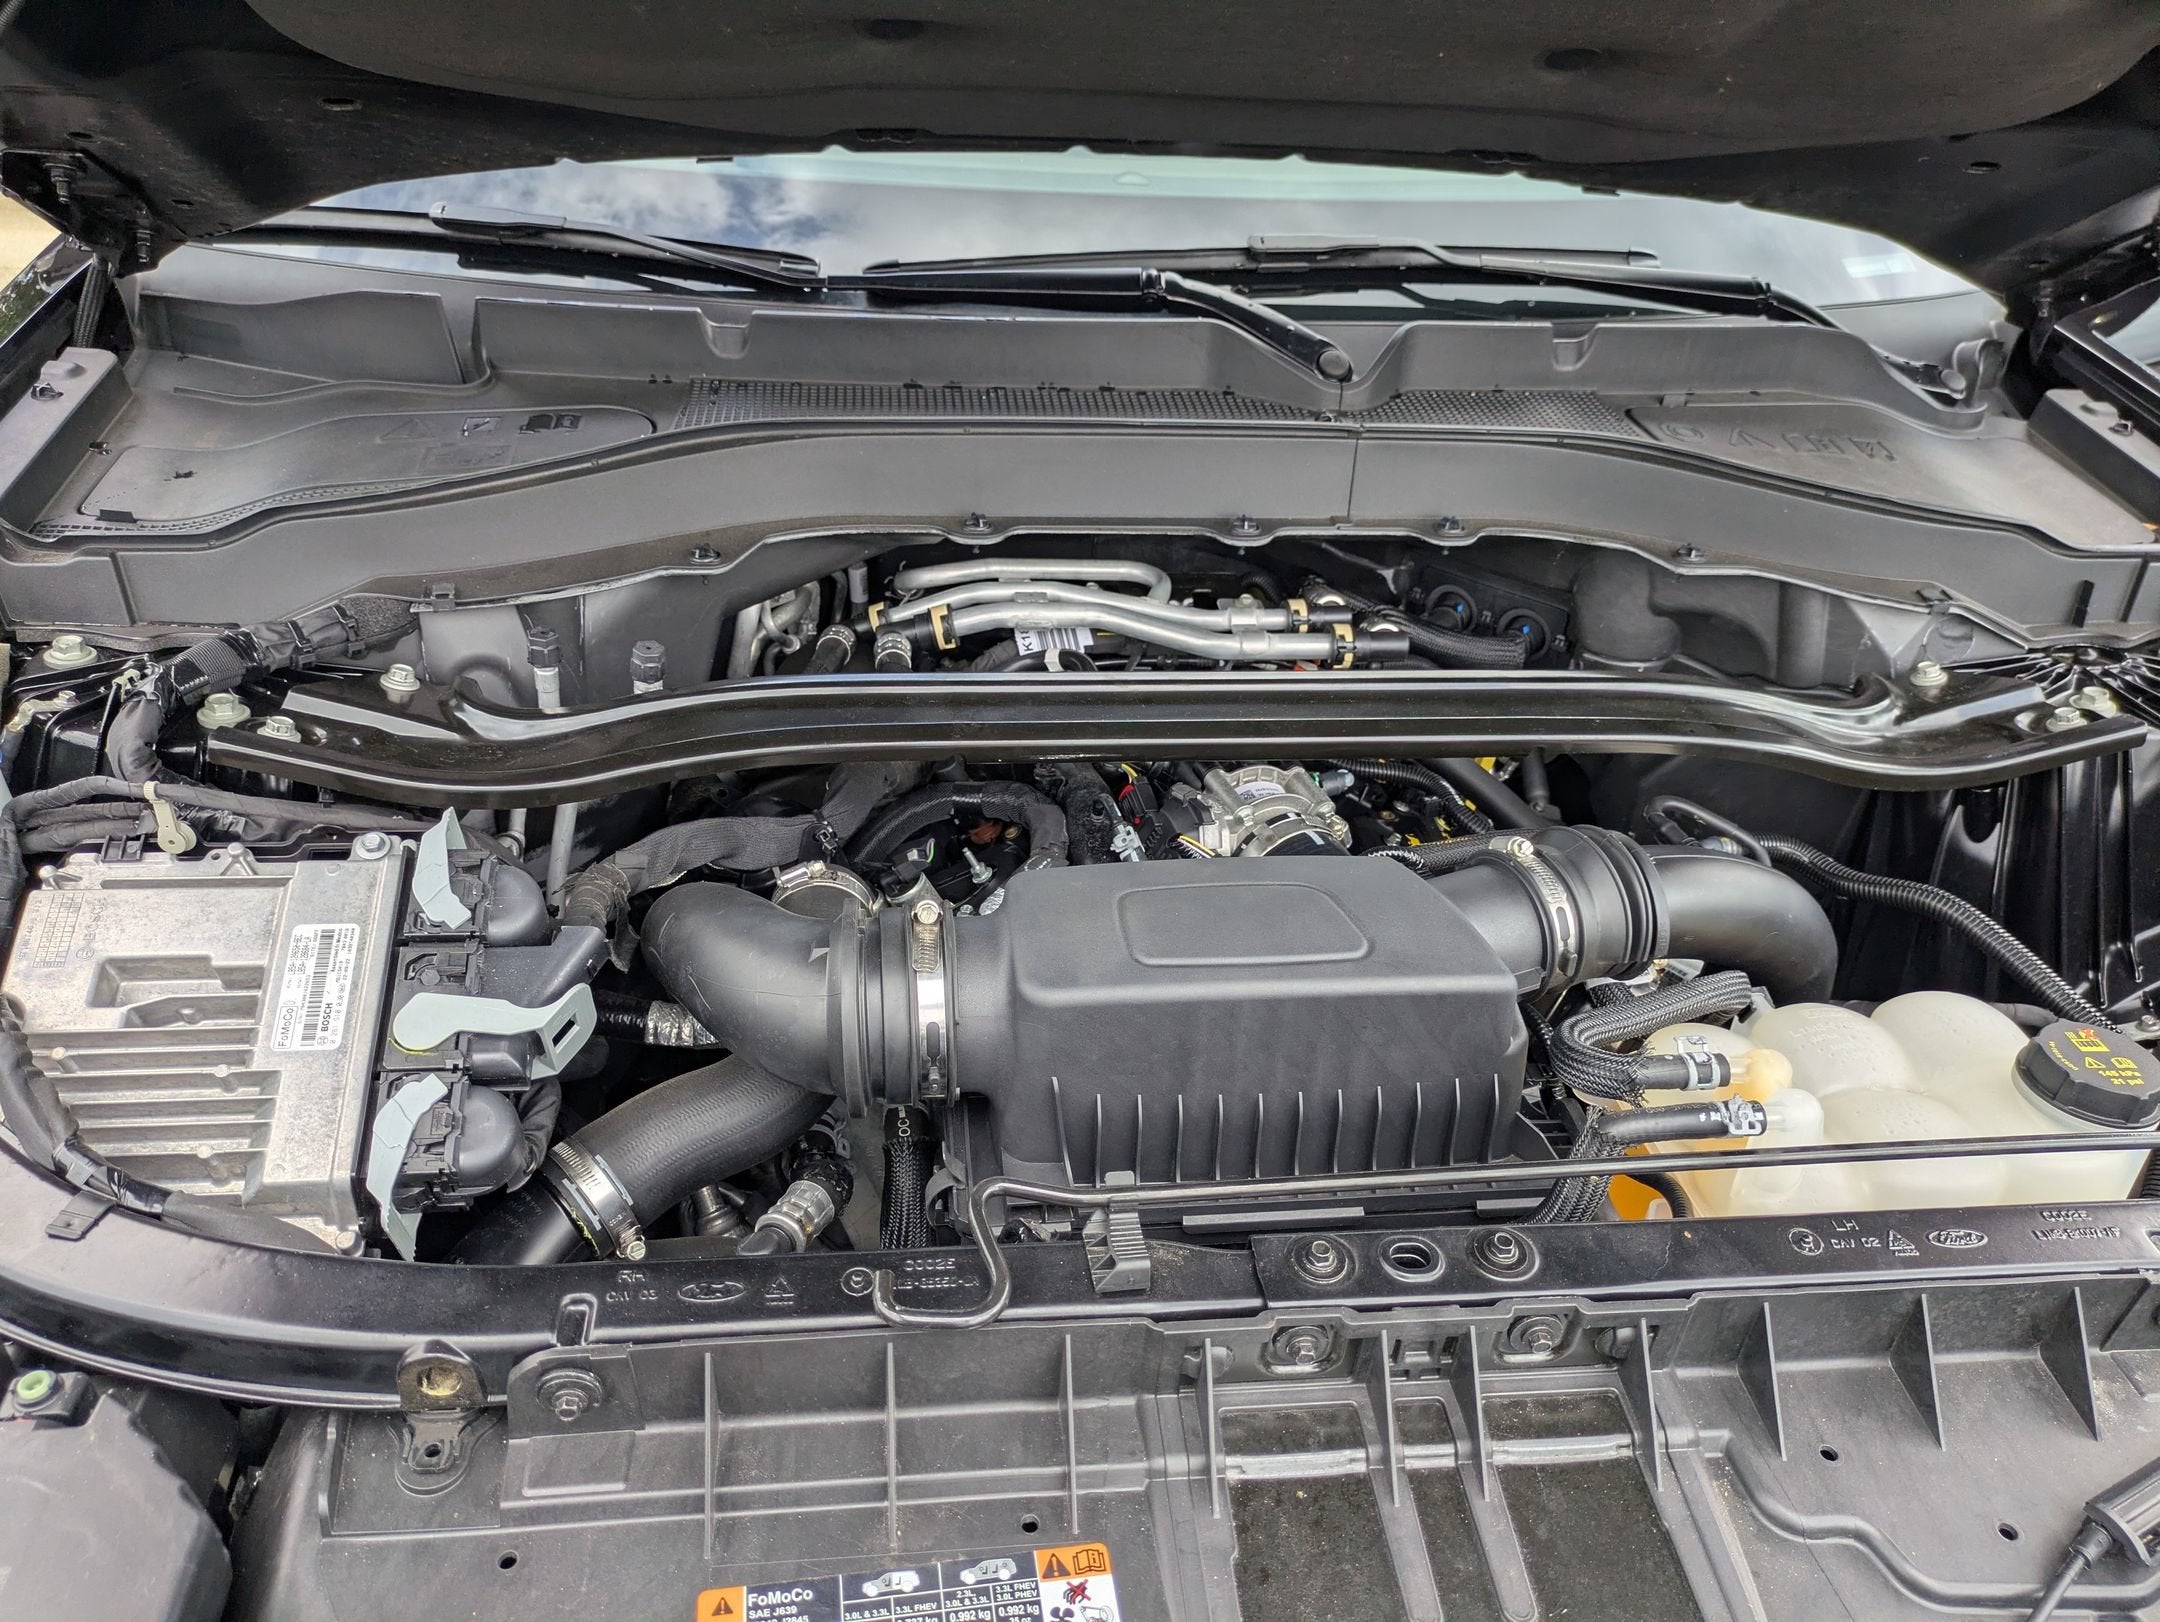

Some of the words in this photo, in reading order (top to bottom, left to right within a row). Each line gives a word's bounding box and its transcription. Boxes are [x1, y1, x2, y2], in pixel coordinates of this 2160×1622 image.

[320, 1003, 334, 1032] BOSCH
[277, 1007, 294, 1047] FoMoCo
[1831, 1216, 1859, 1231] LH
[995, 1585, 1013, 1593] 3.3L
[1013, 1581, 1036, 1591] FHEV
[748, 1588, 813, 1607] FoMoCo
[945, 1599, 963, 1608] 3.0L
[964, 1598, 971, 1606] &
[972, 1595, 990, 1605] 3.3L
[996, 1593, 1014, 1602] 3.0L
[1015, 1589, 1038, 1599] PHEV
[748, 1607, 771, 1619] SAE
[773, 1605, 798, 1618] J639
[844, 1612, 862, 1621] 3.0L
[863, 1610, 871, 1618] &
[872, 1608, 890, 1617] 3.3L
[895, 1605, 913, 1614] 3.3L
[914, 1602, 938, 1612] FHEV
[949, 1610, 977, 1622] 0.992
[978, 1607, 991, 1621] kg
[998, 1604, 1025, 1617] 0.992
[1027, 1603, 1040, 1616] kg
